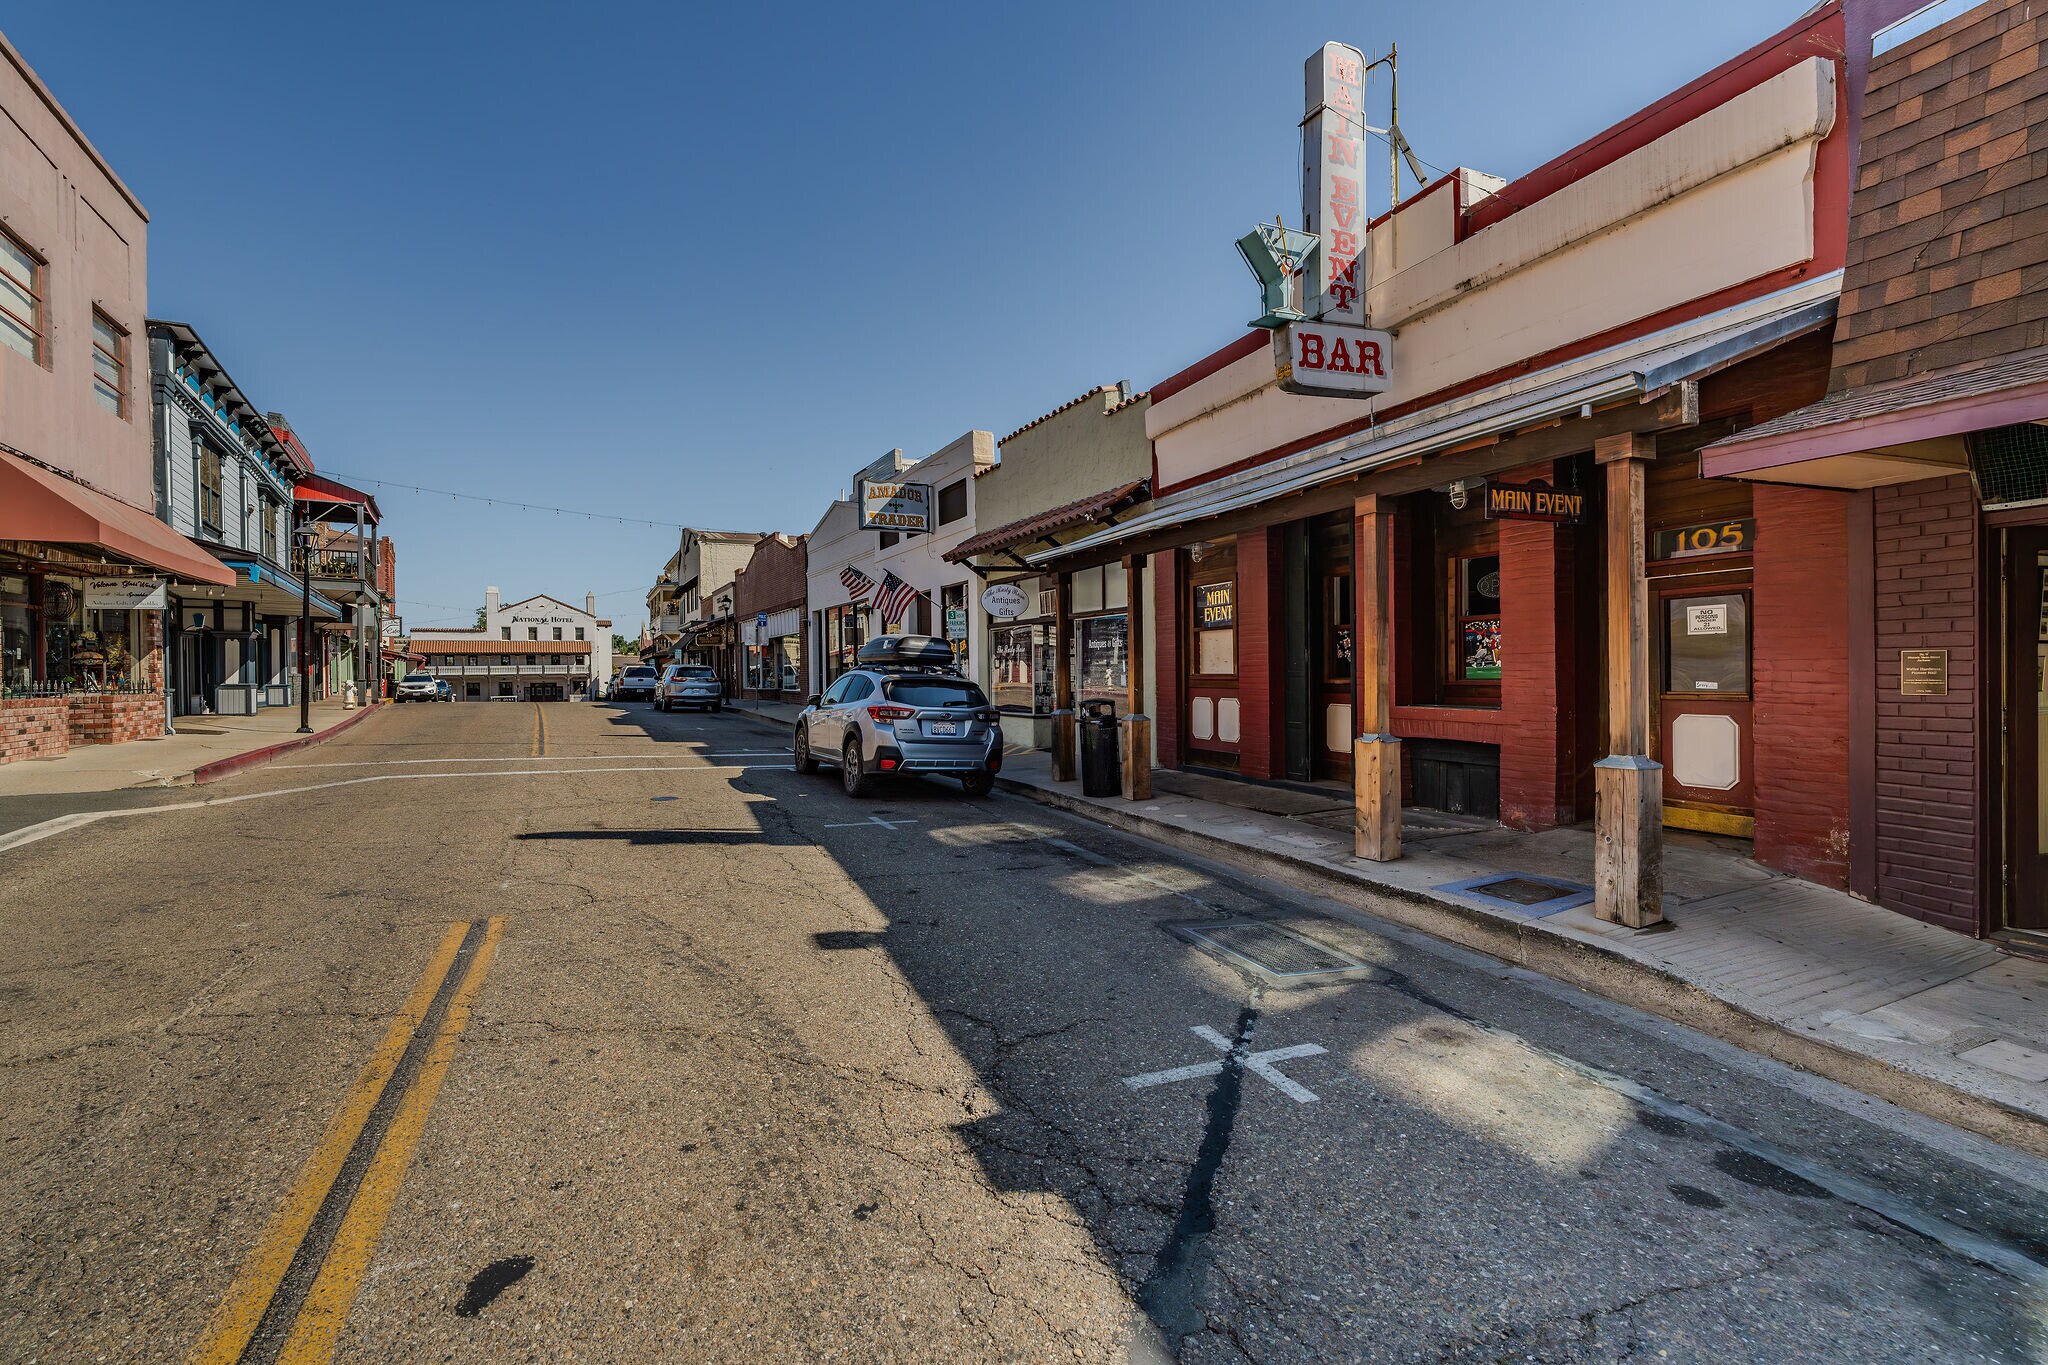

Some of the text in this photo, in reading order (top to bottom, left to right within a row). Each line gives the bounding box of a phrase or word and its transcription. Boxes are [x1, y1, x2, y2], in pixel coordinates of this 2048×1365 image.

[1327, 53, 1359, 311] MAIN EVENT
[1298, 332, 1385, 377] BAR
[869, 485, 923, 503] AMADOR
[1491, 489, 1582, 516] MAIN EVENT
[869, 512, 925, 528] TRADER
[1678, 523, 1744, 551] 105
[991, 596, 1021, 605] Antiques
[1206, 589, 1230, 606] MAIN
[512, 616, 549, 624] NATIONAL
[998, 608, 1014, 616] Gifts
[1204, 605, 1233, 622] EVENT
[1088, 639, 1107, 650] Antiques
